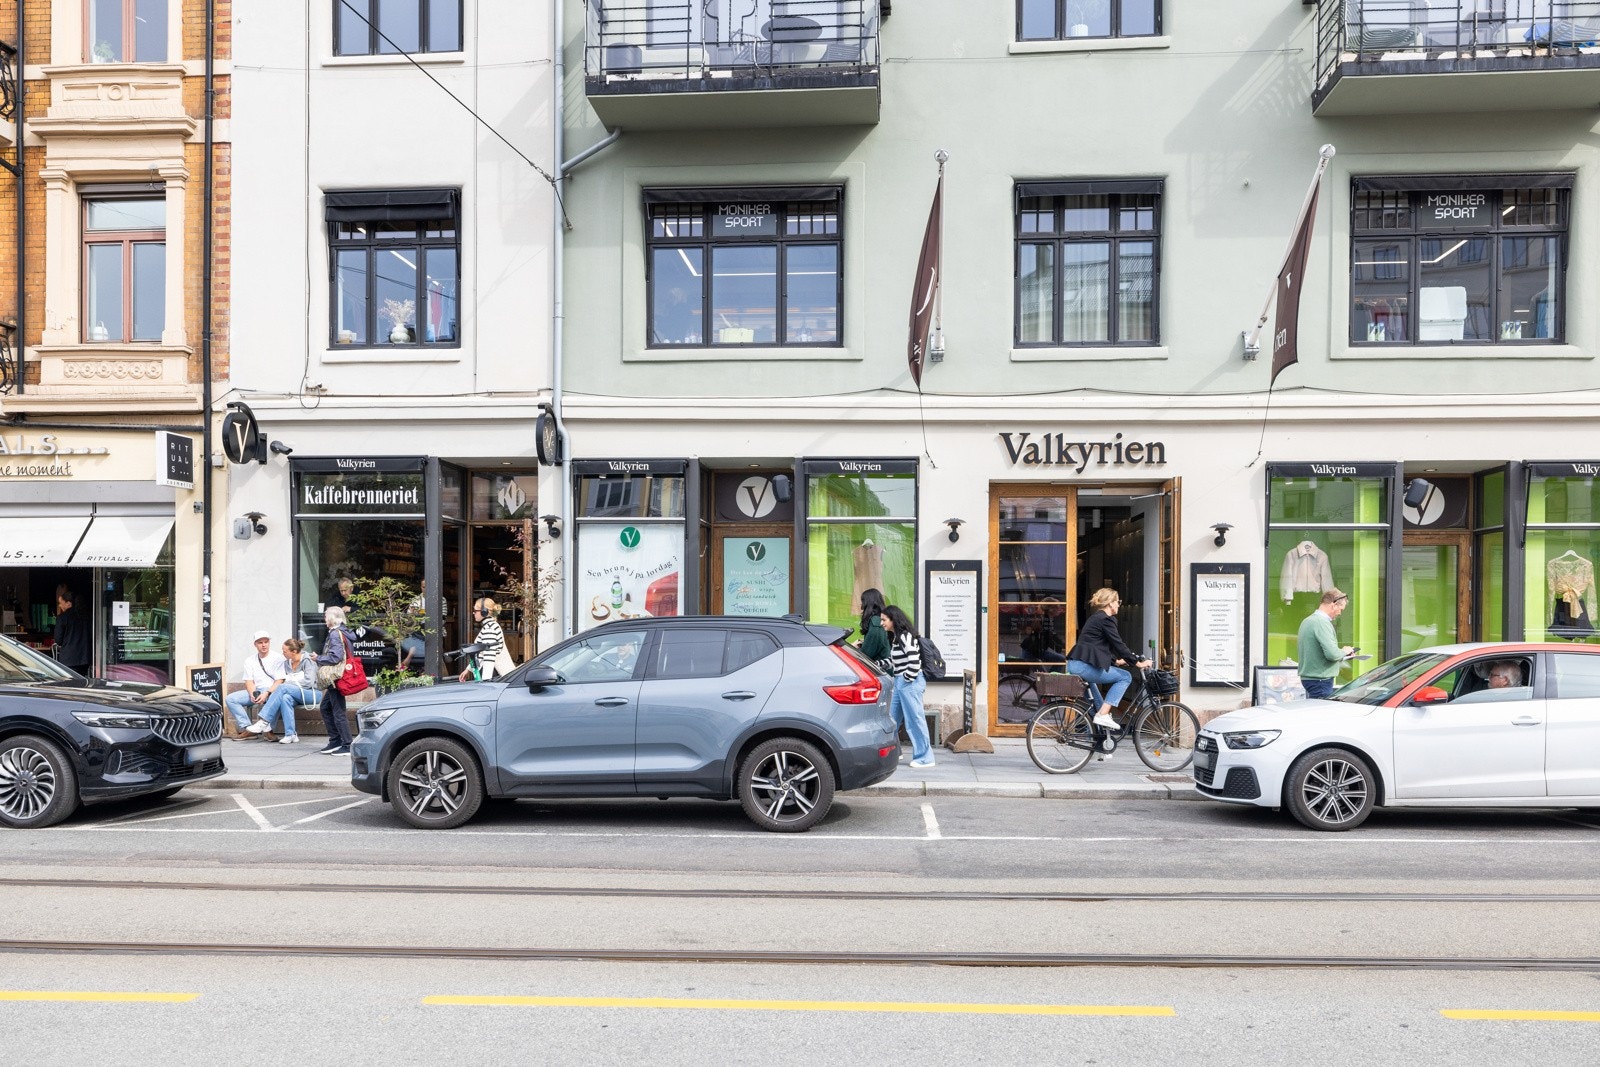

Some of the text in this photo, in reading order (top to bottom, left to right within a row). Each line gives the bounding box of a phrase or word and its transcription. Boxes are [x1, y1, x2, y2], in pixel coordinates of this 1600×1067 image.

[1427, 194, 1486, 207] MONIKER
[718, 204, 771, 215] MONIKER
[1434, 207, 1478, 219] SPORT
[725, 216, 764, 228] SPORT
[999, 432, 1167, 475] Valkyrien
[16, 461, 73, 475] moment
[336, 458, 376, 471] Valkyrien
[608, 461, 650, 473] Valkyrien
[838, 461, 882, 474] Valkyrien
[1310, 464, 1357, 477] Valkyrien
[1571, 463, 1600, 477] Valky
[304, 485, 419, 505] Kaffebrenneriet
[86, 555, 144, 563] RITUALS...
[938, 576, 970, 586] Valkyrien
[1204, 580, 1237, 590] Valkyrien
